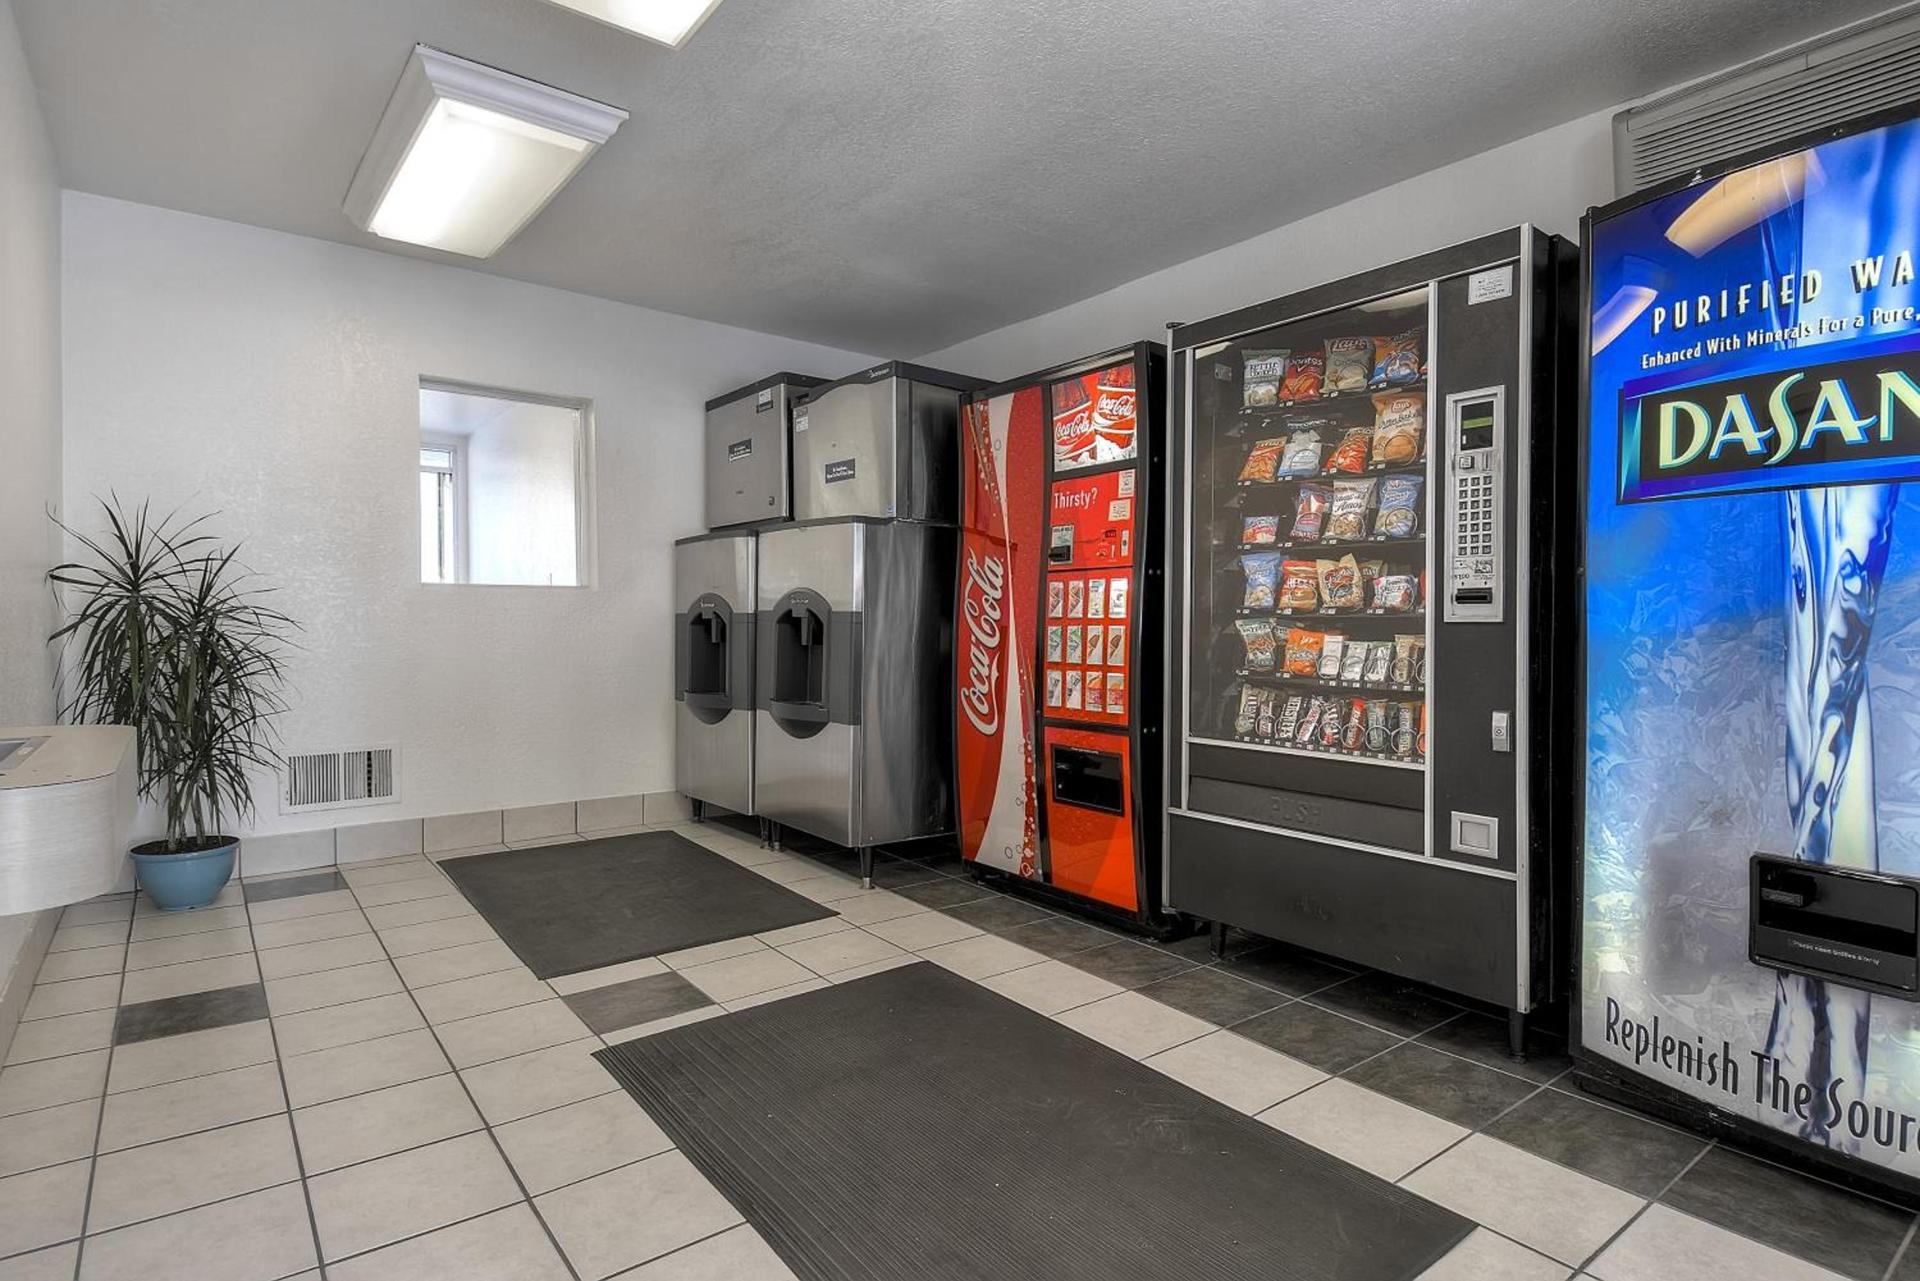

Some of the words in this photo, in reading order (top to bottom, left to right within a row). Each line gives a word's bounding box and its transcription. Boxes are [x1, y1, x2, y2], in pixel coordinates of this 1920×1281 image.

[1651, 269, 1823, 335] PURIFIED
[1641, 343, 1701, 370] Enhanced
[1707, 336, 1741, 354] With
[1746, 323, 1813, 347] Minerals
[1819, 316, 1848, 335] For
[1853, 317, 1865, 328] a
[1054, 487, 1098, 510] Thirsty?
[960, 546, 1005, 736] Coca-Cola
[1604, 996, 1740, 1095] Replenish
[1751, 1049, 1813, 1121] The
[1825, 1077, 1920, 1153] Sour
